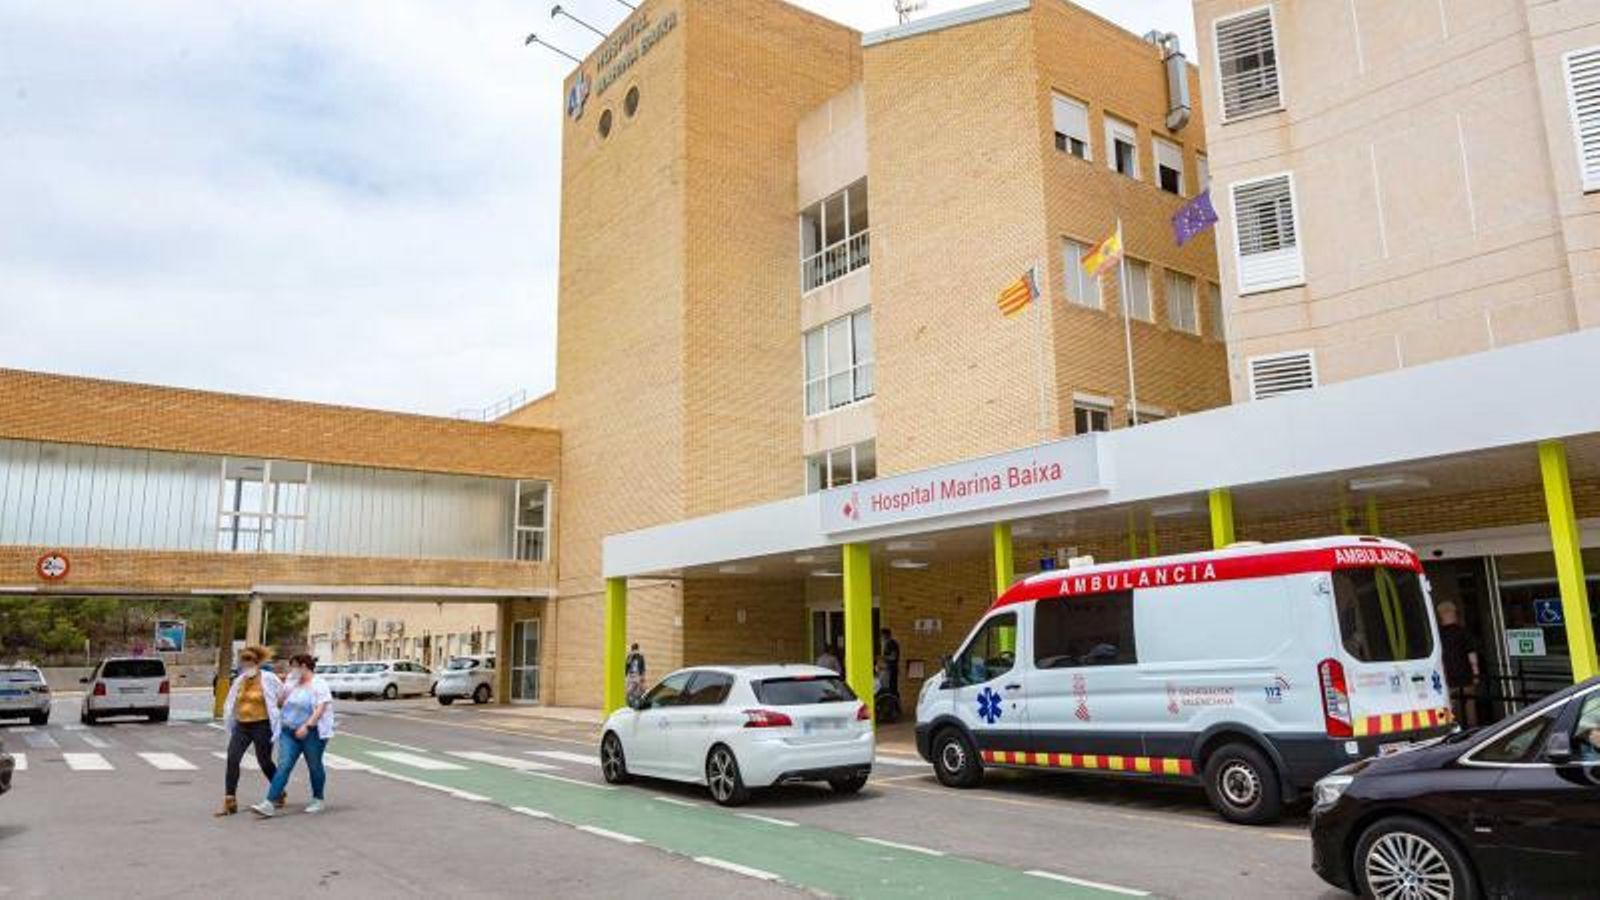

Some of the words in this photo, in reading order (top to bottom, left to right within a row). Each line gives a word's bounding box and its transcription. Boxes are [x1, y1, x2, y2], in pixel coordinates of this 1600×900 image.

[871, 481, 936, 513] Hospital
[940, 473, 1001, 500] Marina
[1008, 461, 1062, 488] Baixa
[1334, 547, 1415, 567] AMBULANCIA
[1059, 562, 1217, 595] AMBULANCIA
